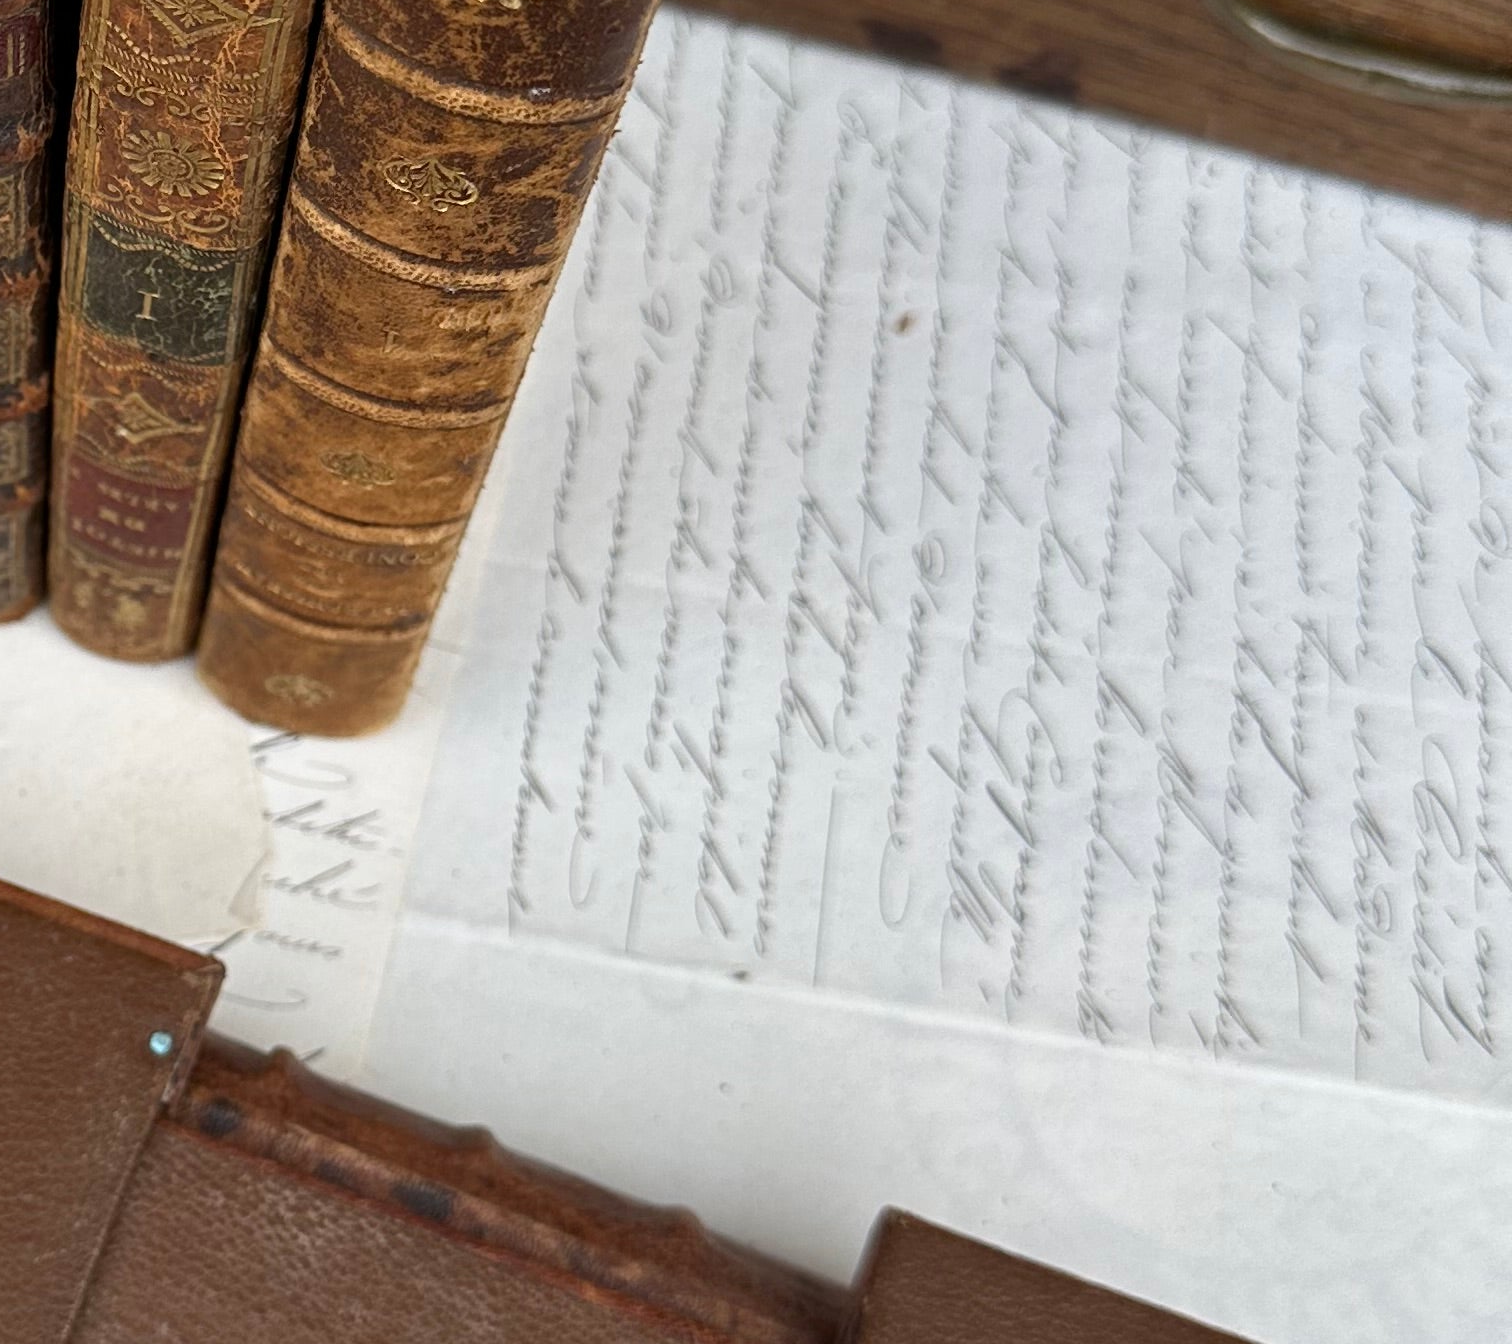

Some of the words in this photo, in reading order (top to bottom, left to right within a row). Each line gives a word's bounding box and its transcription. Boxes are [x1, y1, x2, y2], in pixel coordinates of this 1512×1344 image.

[136, 290, 161, 322] I
[1354, 346, 1395, 672] Monsieur
[1350, 769, 1397, 1054] Madame
[1409, 735, 1471, 1067] Crédit
